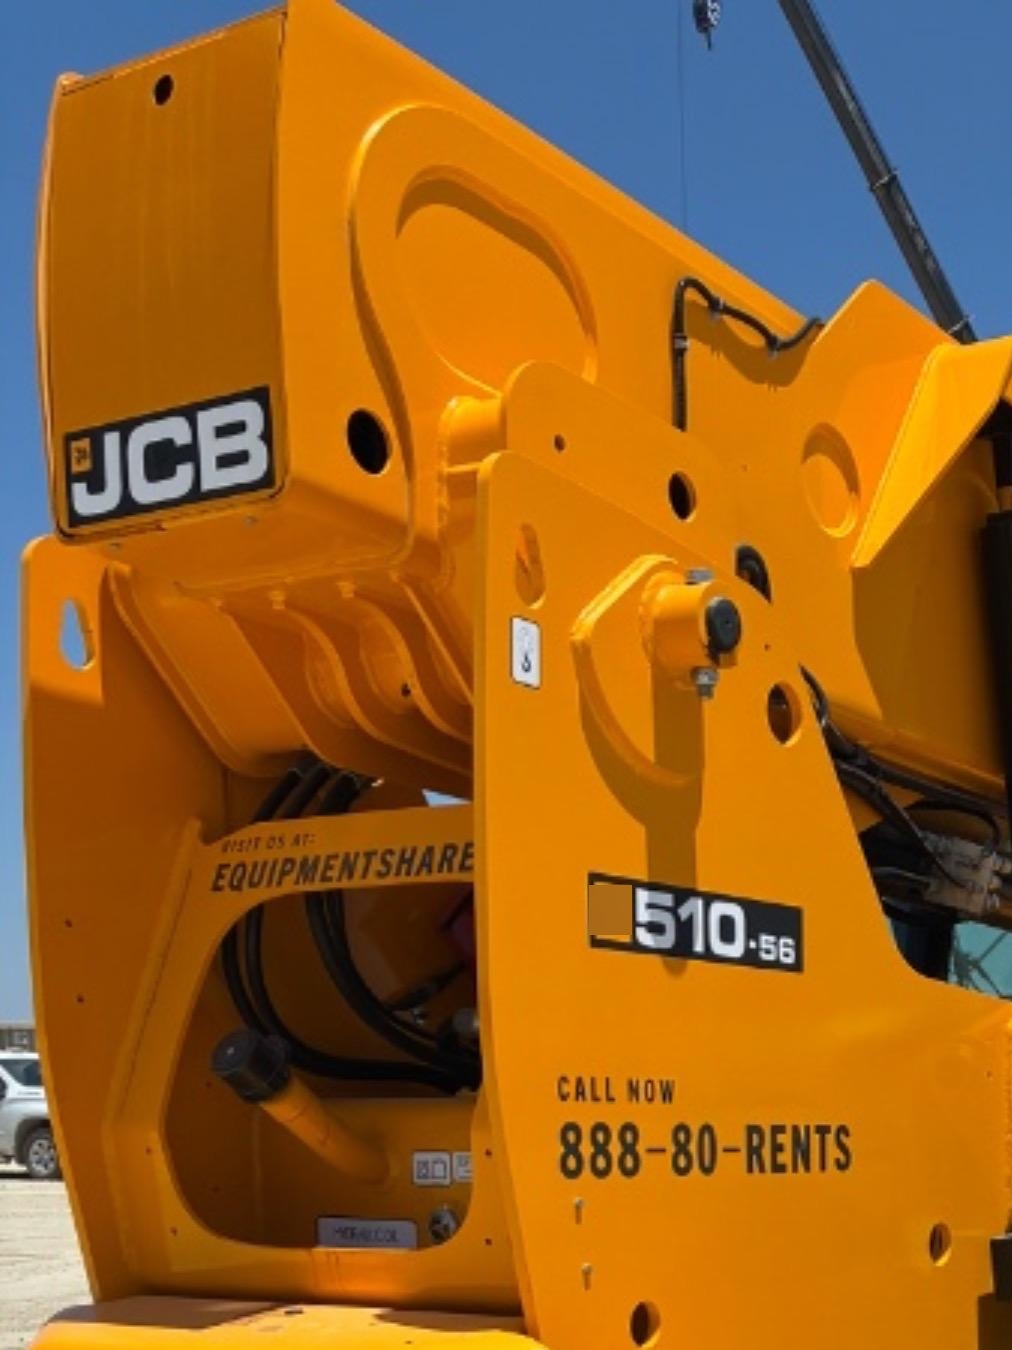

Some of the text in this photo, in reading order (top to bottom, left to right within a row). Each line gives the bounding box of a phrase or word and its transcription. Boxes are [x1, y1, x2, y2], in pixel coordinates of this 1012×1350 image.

[71, 400, 269, 516] JCB
[557, 1076, 675, 1104] CALL NOW
[560, 1121, 852, 1179] 888-80-RENTS
